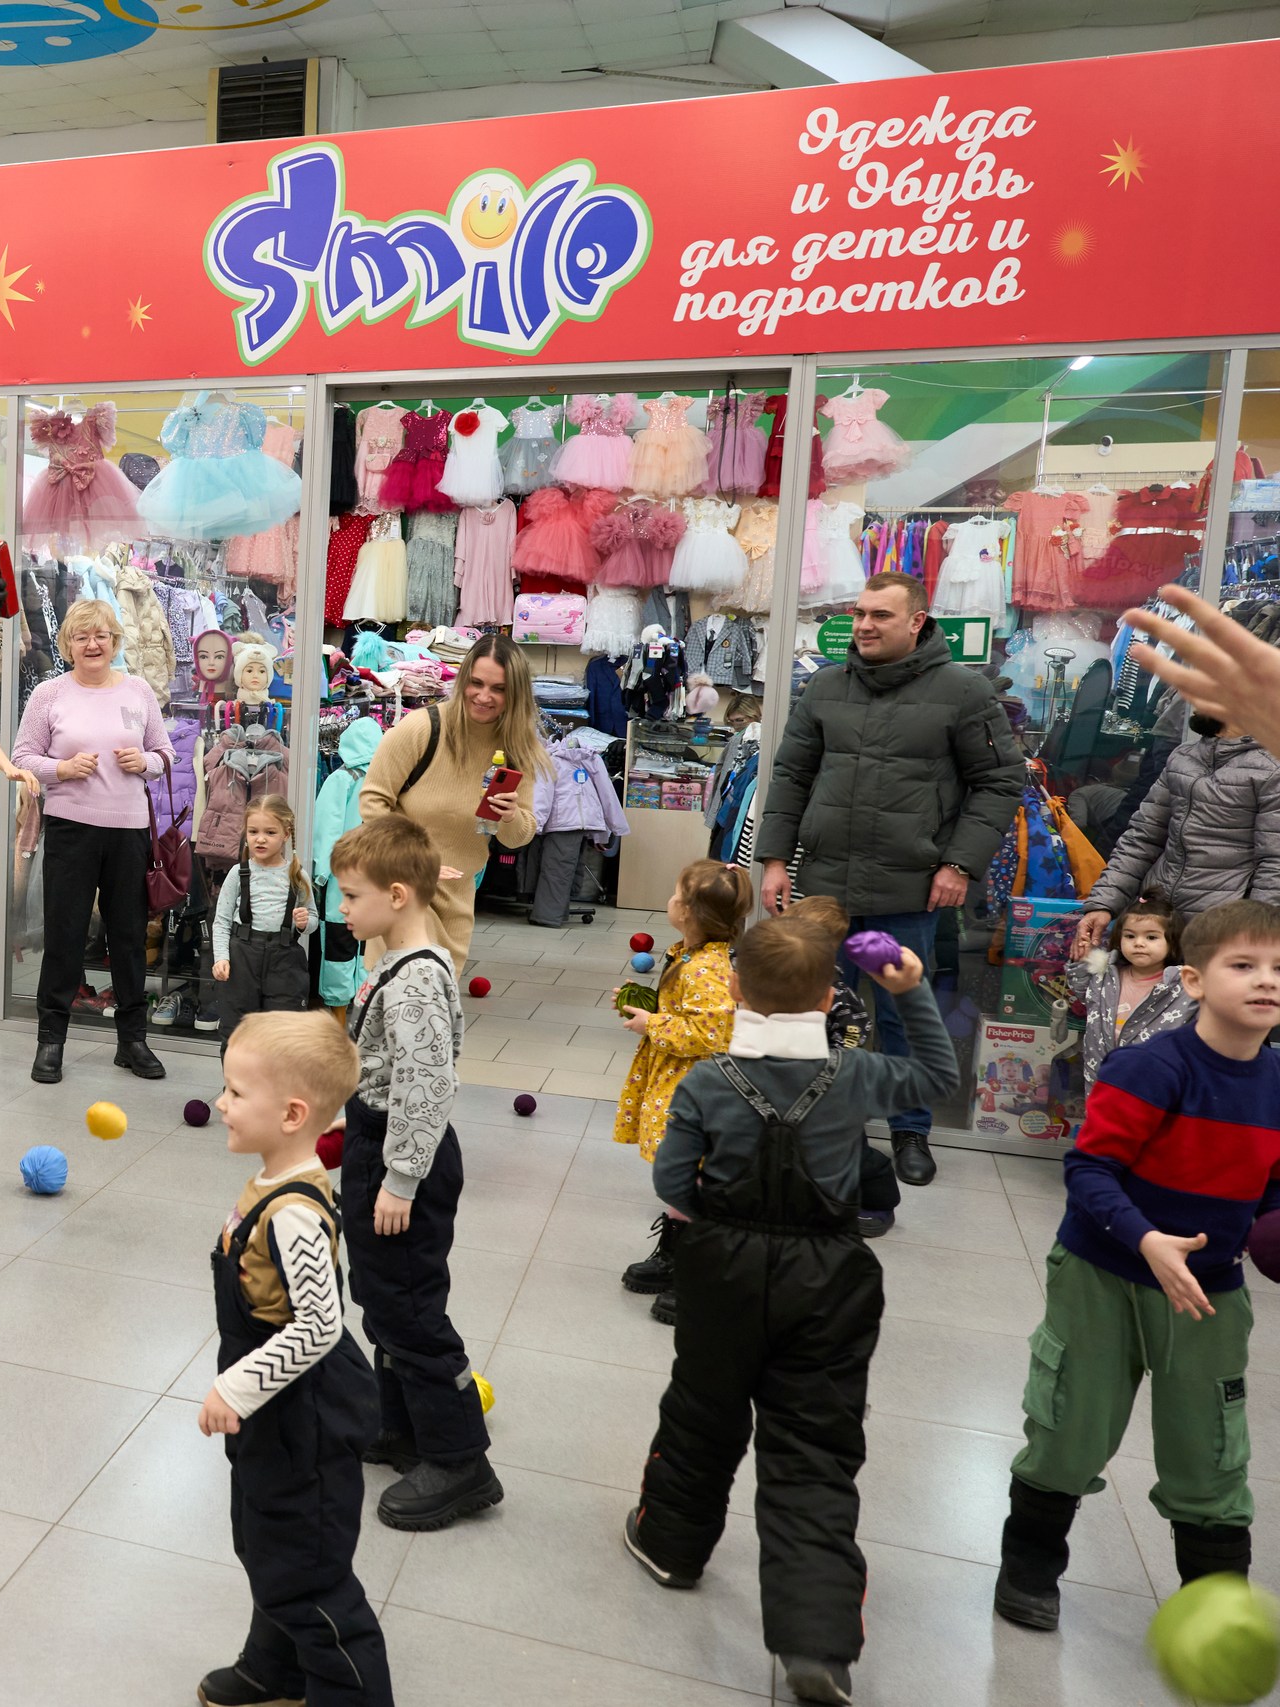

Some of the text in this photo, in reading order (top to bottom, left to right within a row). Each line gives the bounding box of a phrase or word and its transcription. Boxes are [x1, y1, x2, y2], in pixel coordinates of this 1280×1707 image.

[798, 95, 1037, 172] Одежда
[790, 152, 1035, 224] и Обувь
[207, 146, 647, 358] Smile
[679, 210, 1031, 289] для детей и
[672, 256, 1026, 337] подростков
[987, 1027, 1034, 1040] Fisher-Price
